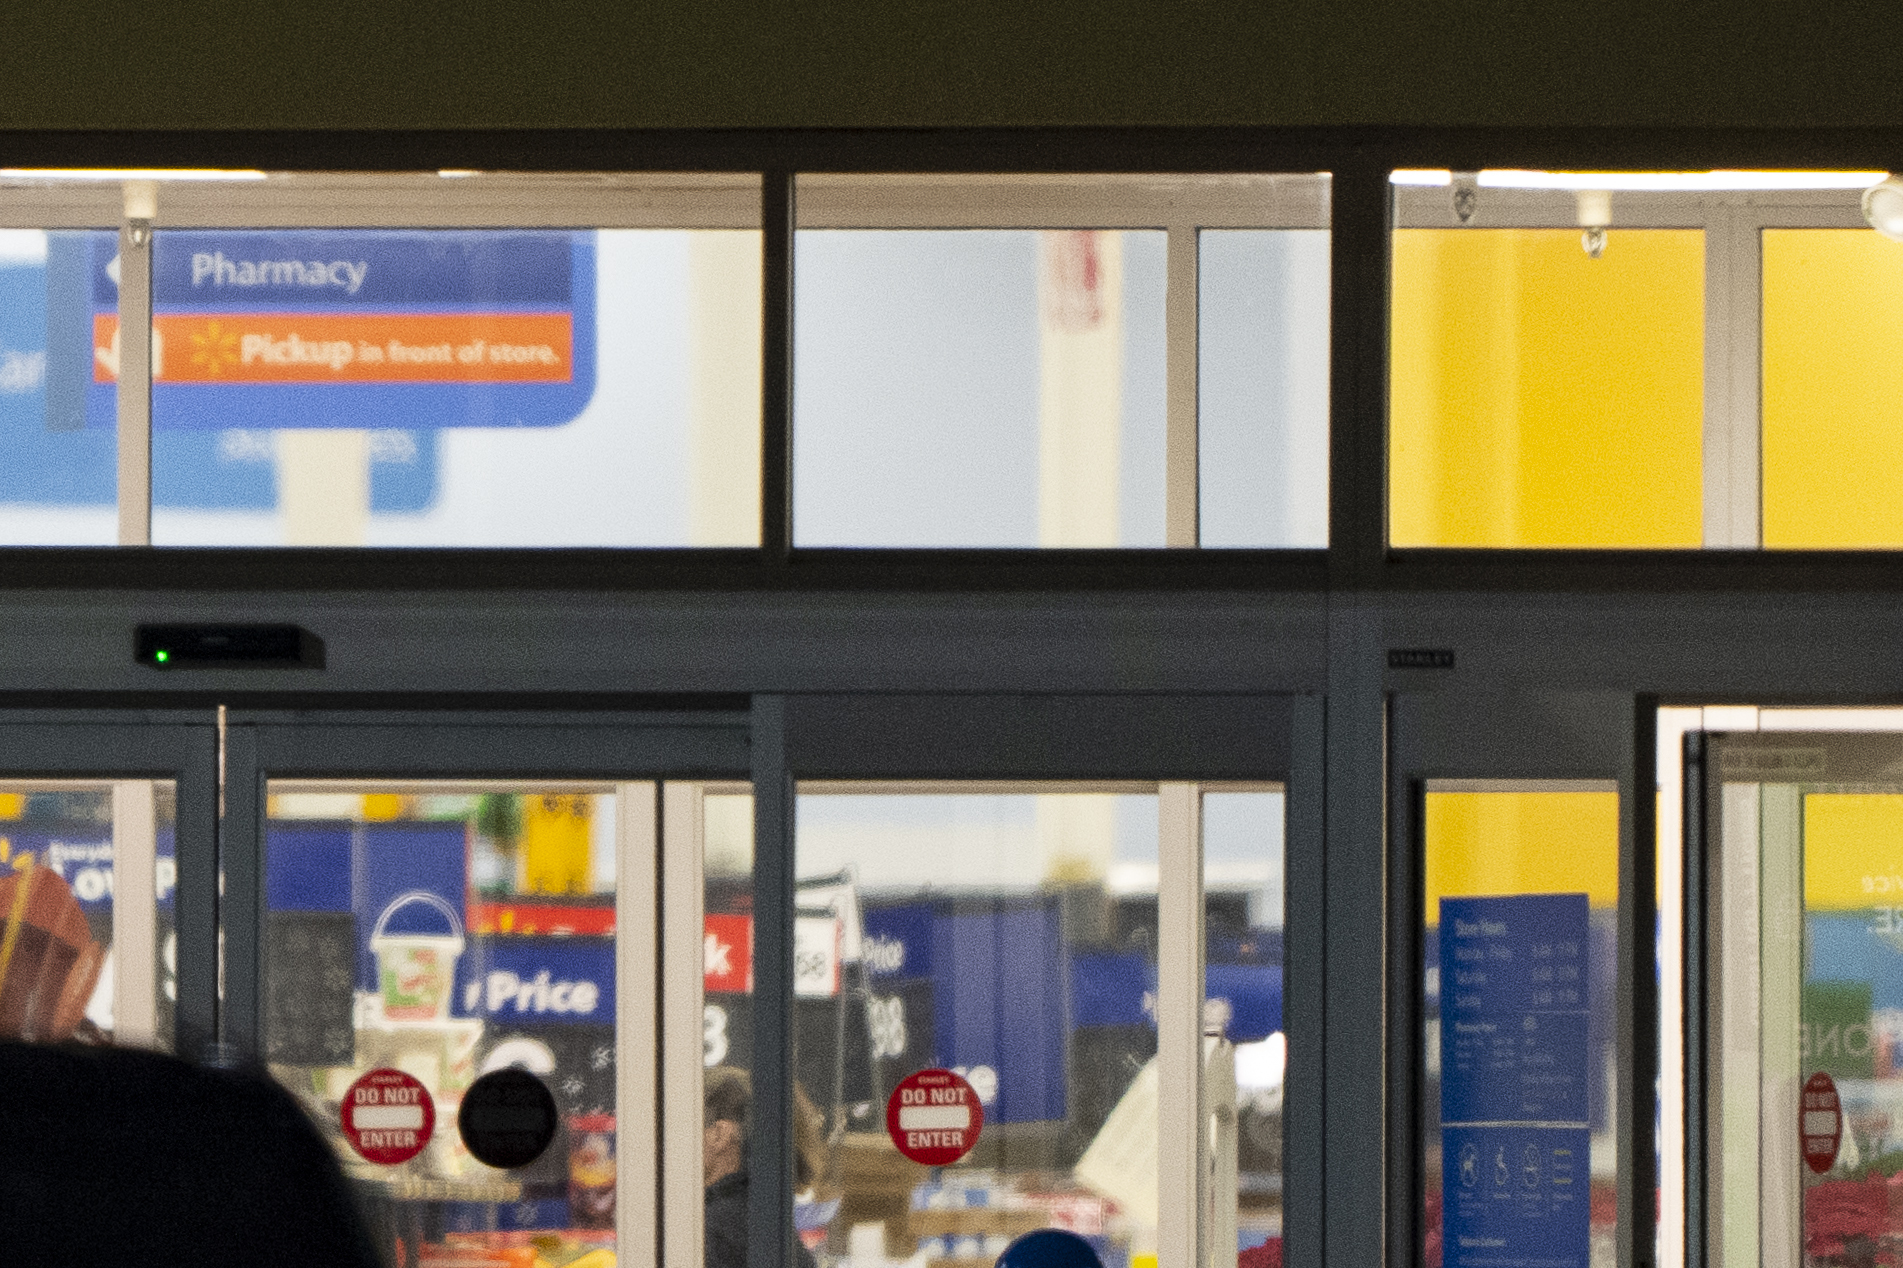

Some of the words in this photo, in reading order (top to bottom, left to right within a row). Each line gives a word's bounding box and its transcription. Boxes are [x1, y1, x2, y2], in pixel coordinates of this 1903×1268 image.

[191, 252, 368, 292] Pharmacy
[241, 332, 354, 370] Pickup
[387, 338, 452, 363] front
[456, 339, 485, 363] of
[487, 968, 599, 1014] Price
[354, 1088, 379, 1104] DO
[383, 1087, 420, 1104] NOT
[901, 1088, 927, 1104] DO
[930, 1088, 967, 1103] NOT
[359, 1130, 417, 1149] ENTER
[907, 1131, 964, 1148] ENTER
